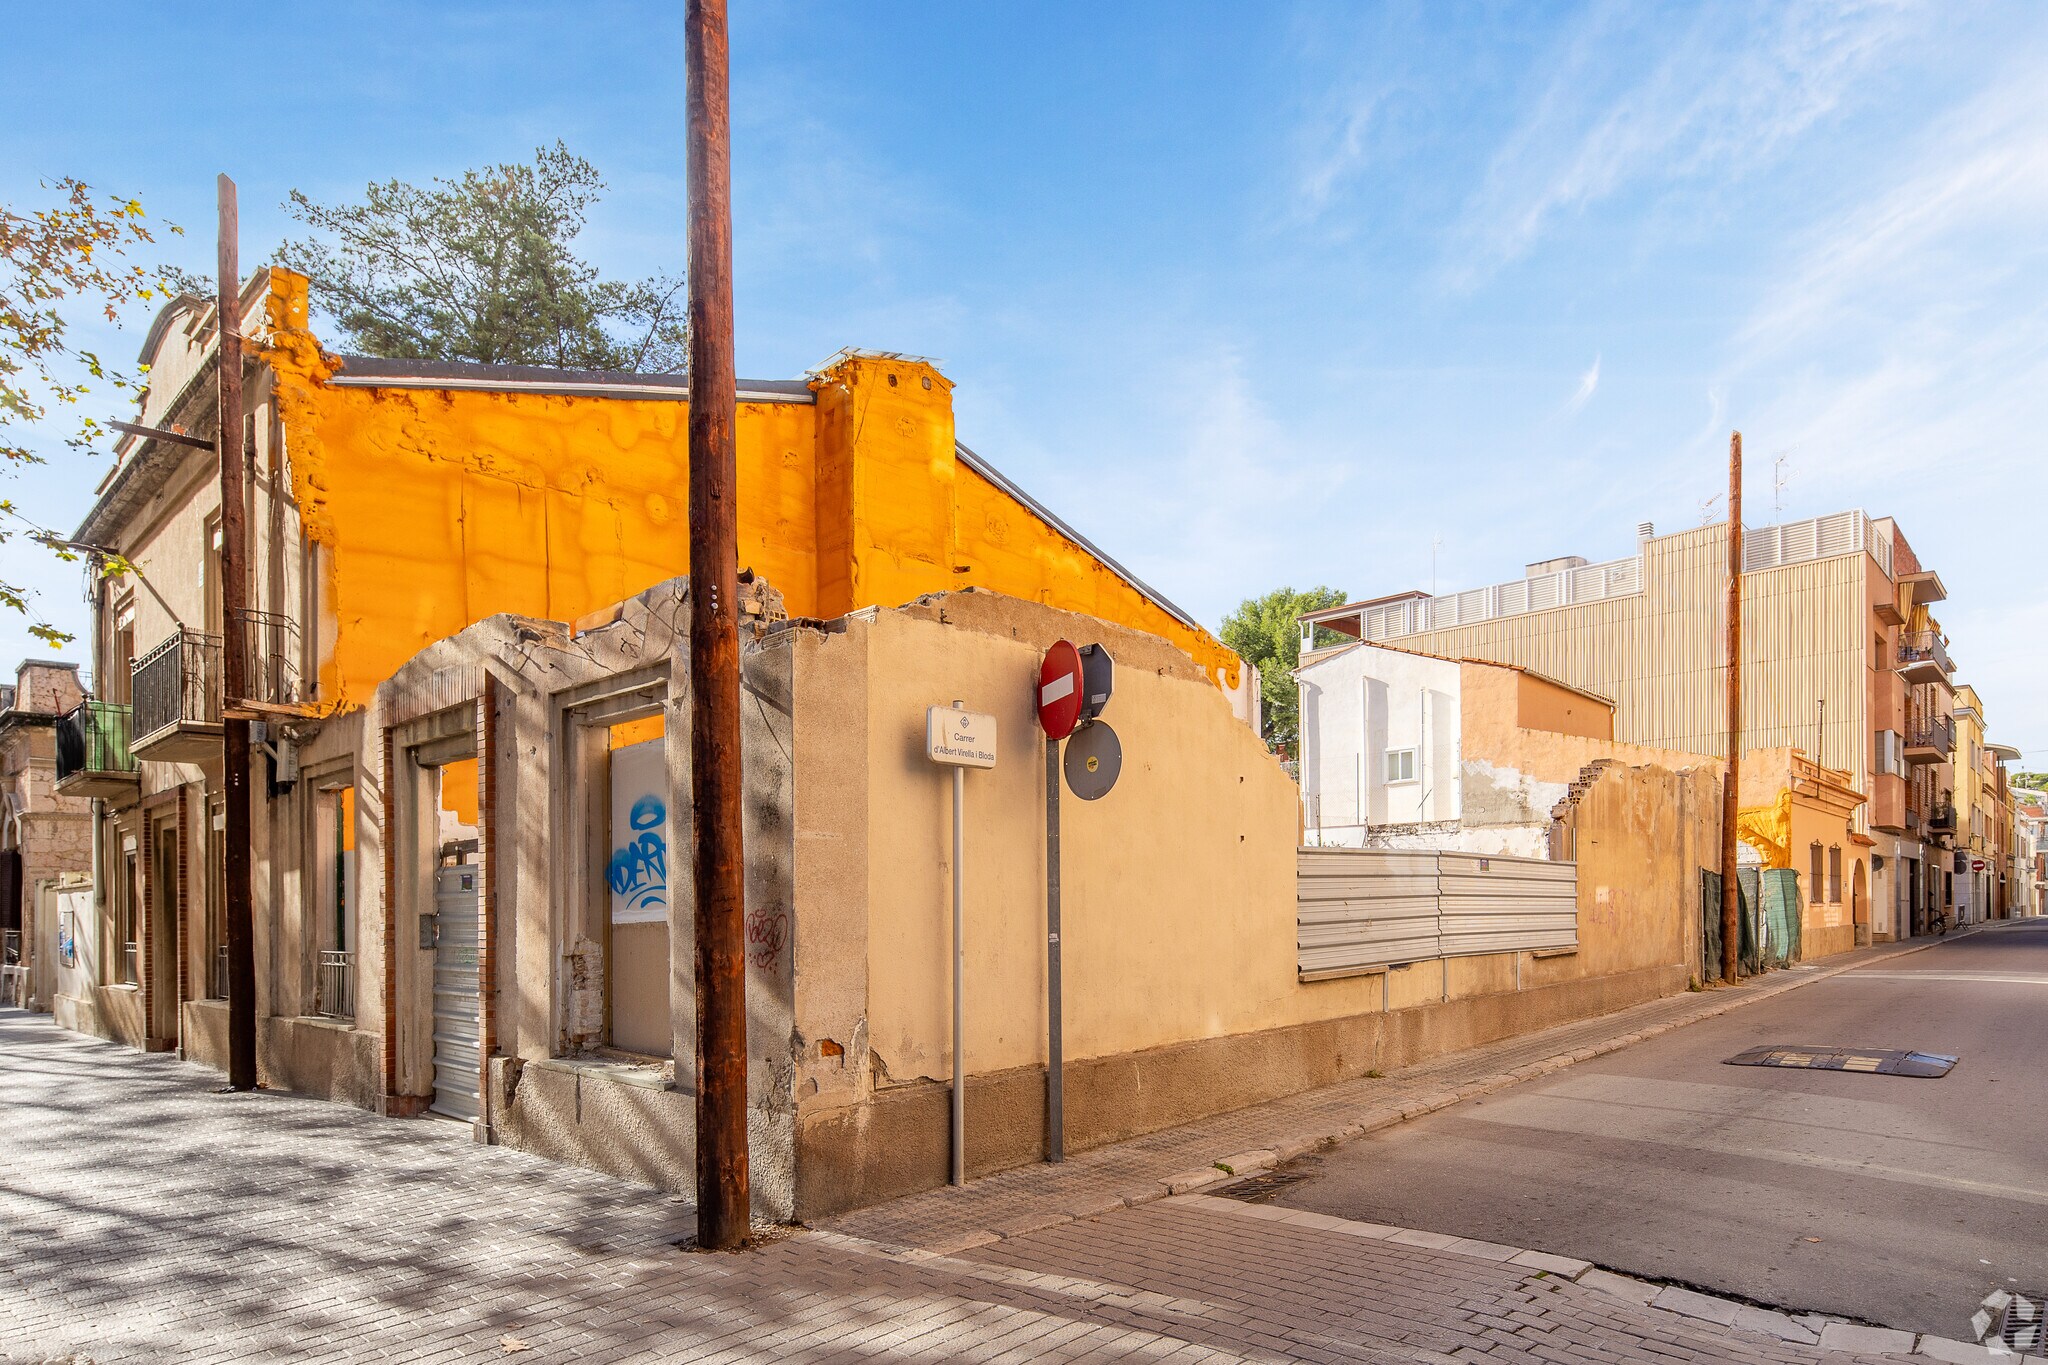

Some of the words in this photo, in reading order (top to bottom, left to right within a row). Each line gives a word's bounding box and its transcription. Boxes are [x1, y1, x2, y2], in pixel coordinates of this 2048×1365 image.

[954, 732, 975, 742] Carrer
[934, 745, 957, 755] d'Albert
[957, 748, 974, 757] Virella
[978, 751, 994, 760] Bloda
